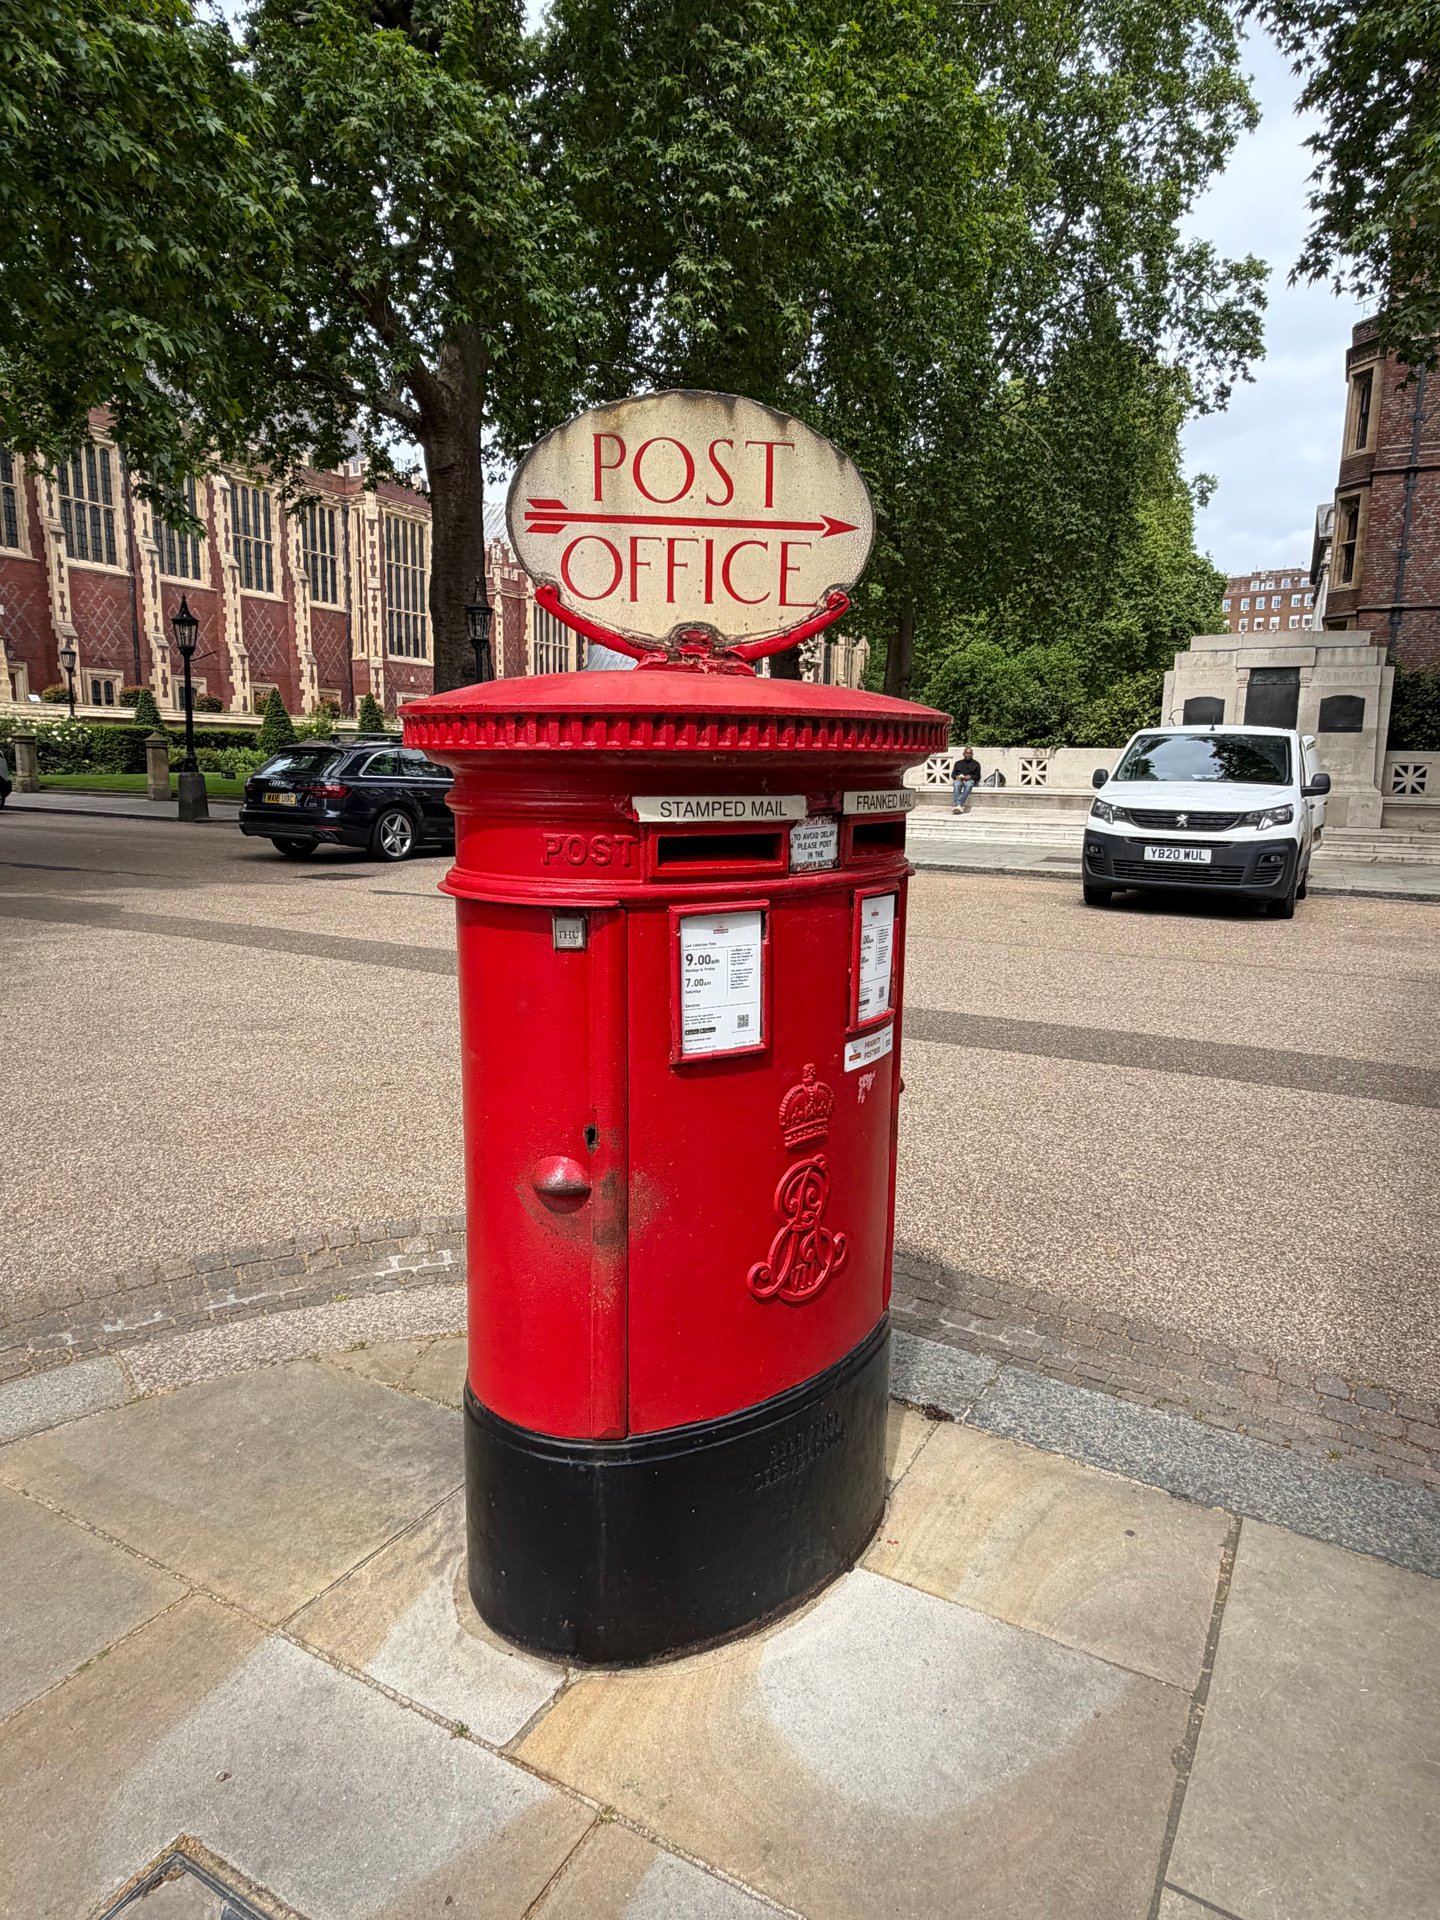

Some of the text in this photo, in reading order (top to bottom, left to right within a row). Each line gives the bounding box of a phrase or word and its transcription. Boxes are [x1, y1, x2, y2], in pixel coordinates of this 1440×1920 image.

[592, 433, 796, 508] POST
[560, 534, 818, 608] OFFICE
[660, 801, 788, 818] STAMPED MAIL
[856, 794, 898, 811] FRANKED
[793, 830, 835, 841] TO AVOID DELAY
[542, 832, 639, 868] POST
[797, 840, 832, 851] PLEASE POST
[815, 850, 824, 858] THE
[1151, 847, 1206, 862] YB20 WUL
[556, 930, 579, 940] THU
[685, 953, 720, 967] 9.00am
